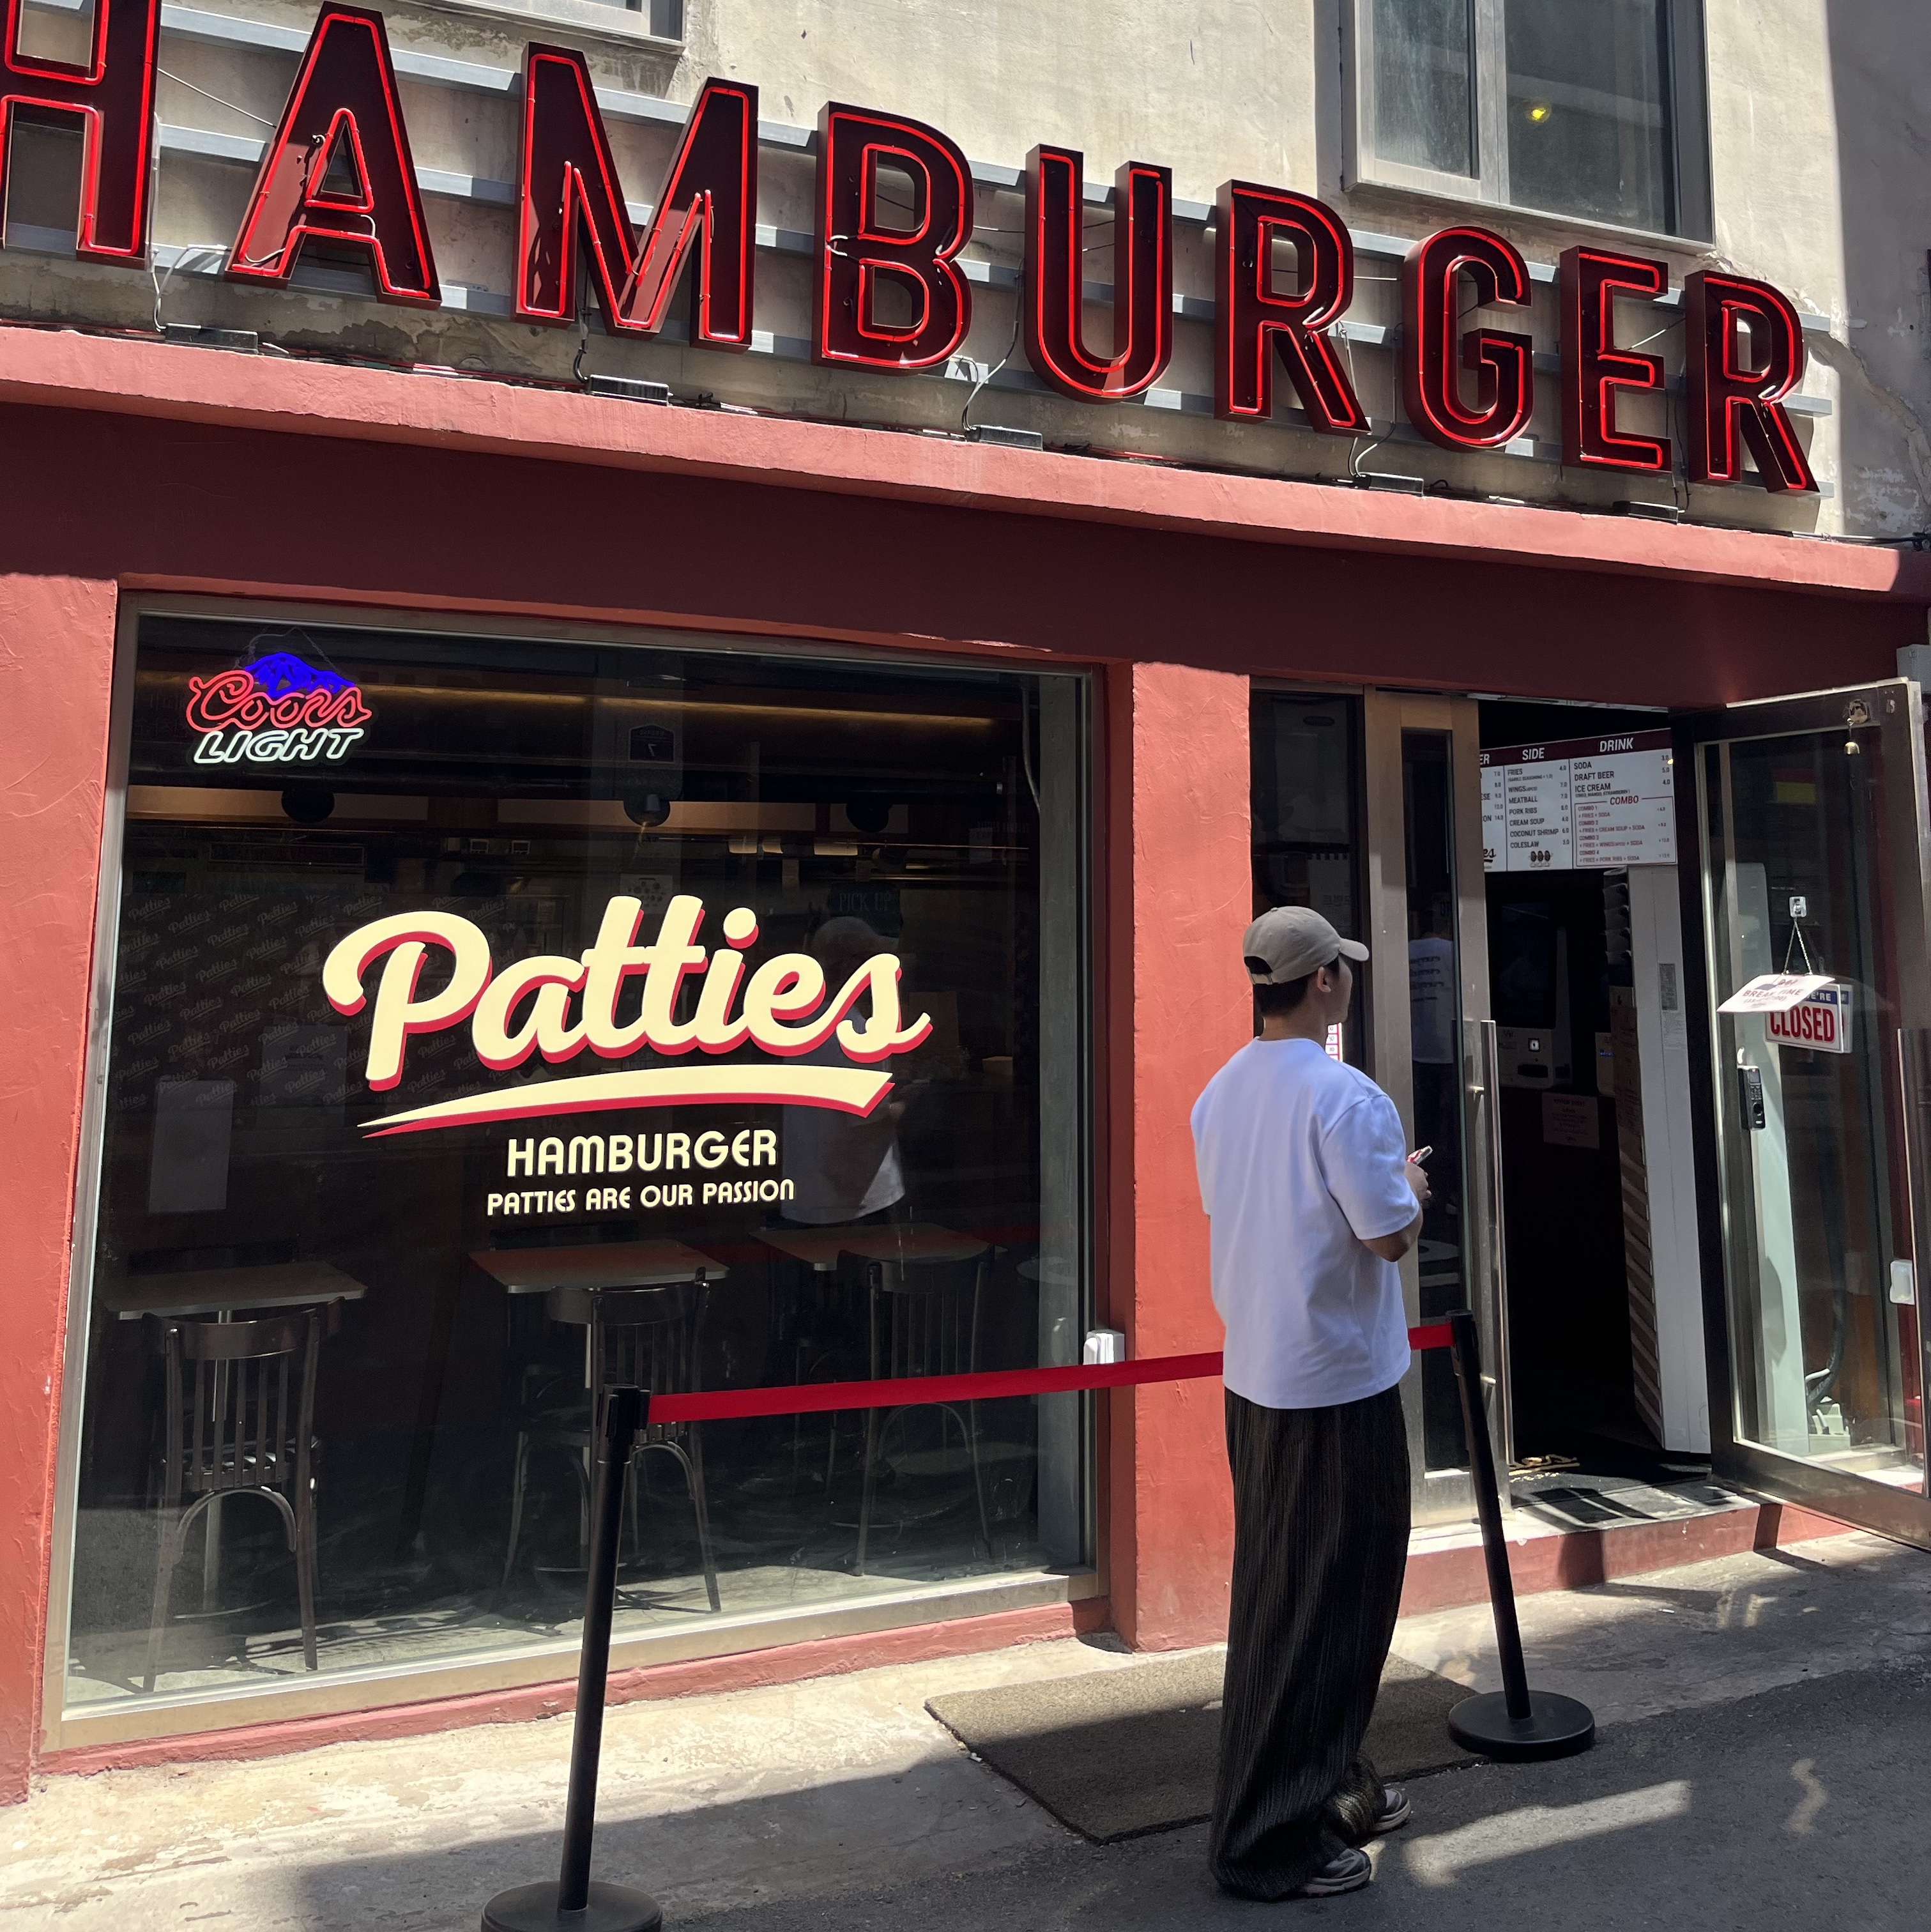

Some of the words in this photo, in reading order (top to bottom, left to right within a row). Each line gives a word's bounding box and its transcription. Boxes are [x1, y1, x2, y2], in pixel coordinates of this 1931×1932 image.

[0, 0, 1819, 494] HAMBURGER
[186, 670, 372, 733] Coors
[194, 728, 365, 764] LIGHT
[1522, 747, 1545, 761] SIDE
[1599, 737, 1634, 753] DRINK
[1574, 761, 1592, 770] SODA
[1574, 772, 1596, 781] DRAFT
[1598, 770, 1615, 779] BEER
[1509, 796, 1538, 804] MEATBALL
[1575, 785, 1585, 793] ICE
[1587, 783, 1611, 792] CREAM
[1610, 795, 1639, 806] COMBO
[1509, 829, 1536, 838] COCONUT
[1510, 841, 1539, 849] COLESLAW
[168, 910, 212, 934] Patties
[257, 901, 298, 926] Patties
[207, 924, 250, 947] Patties
[155, 946, 201, 970] Patties
[247, 937, 287, 960] Patties
[195, 958, 238, 983] Patties
[231, 973, 273, 997] Patties
[323, 894, 933, 1091] Patties
[1807, 990, 1831, 1002] E'RE
[219, 1009, 262, 1033] Patties
[1770, 1005, 1835, 1043] CLOSED
[208, 1045, 250, 1069] Patties
[296, 1034, 337, 1057] Patties
[418, 1034, 457, 1059] Patties
[246, 1056, 288, 1081] Patties
[285, 1069, 326, 1093] Patties
[407, 1070, 446, 1093] Patties
[507, 1129, 777, 1177] HAMBURGER
[487, 1189, 576, 1216] PATTIES
[586, 1186, 630, 1211] ARE
[639, 1183, 694, 1208] OUR
[703, 1179, 795, 1205] PASSION
